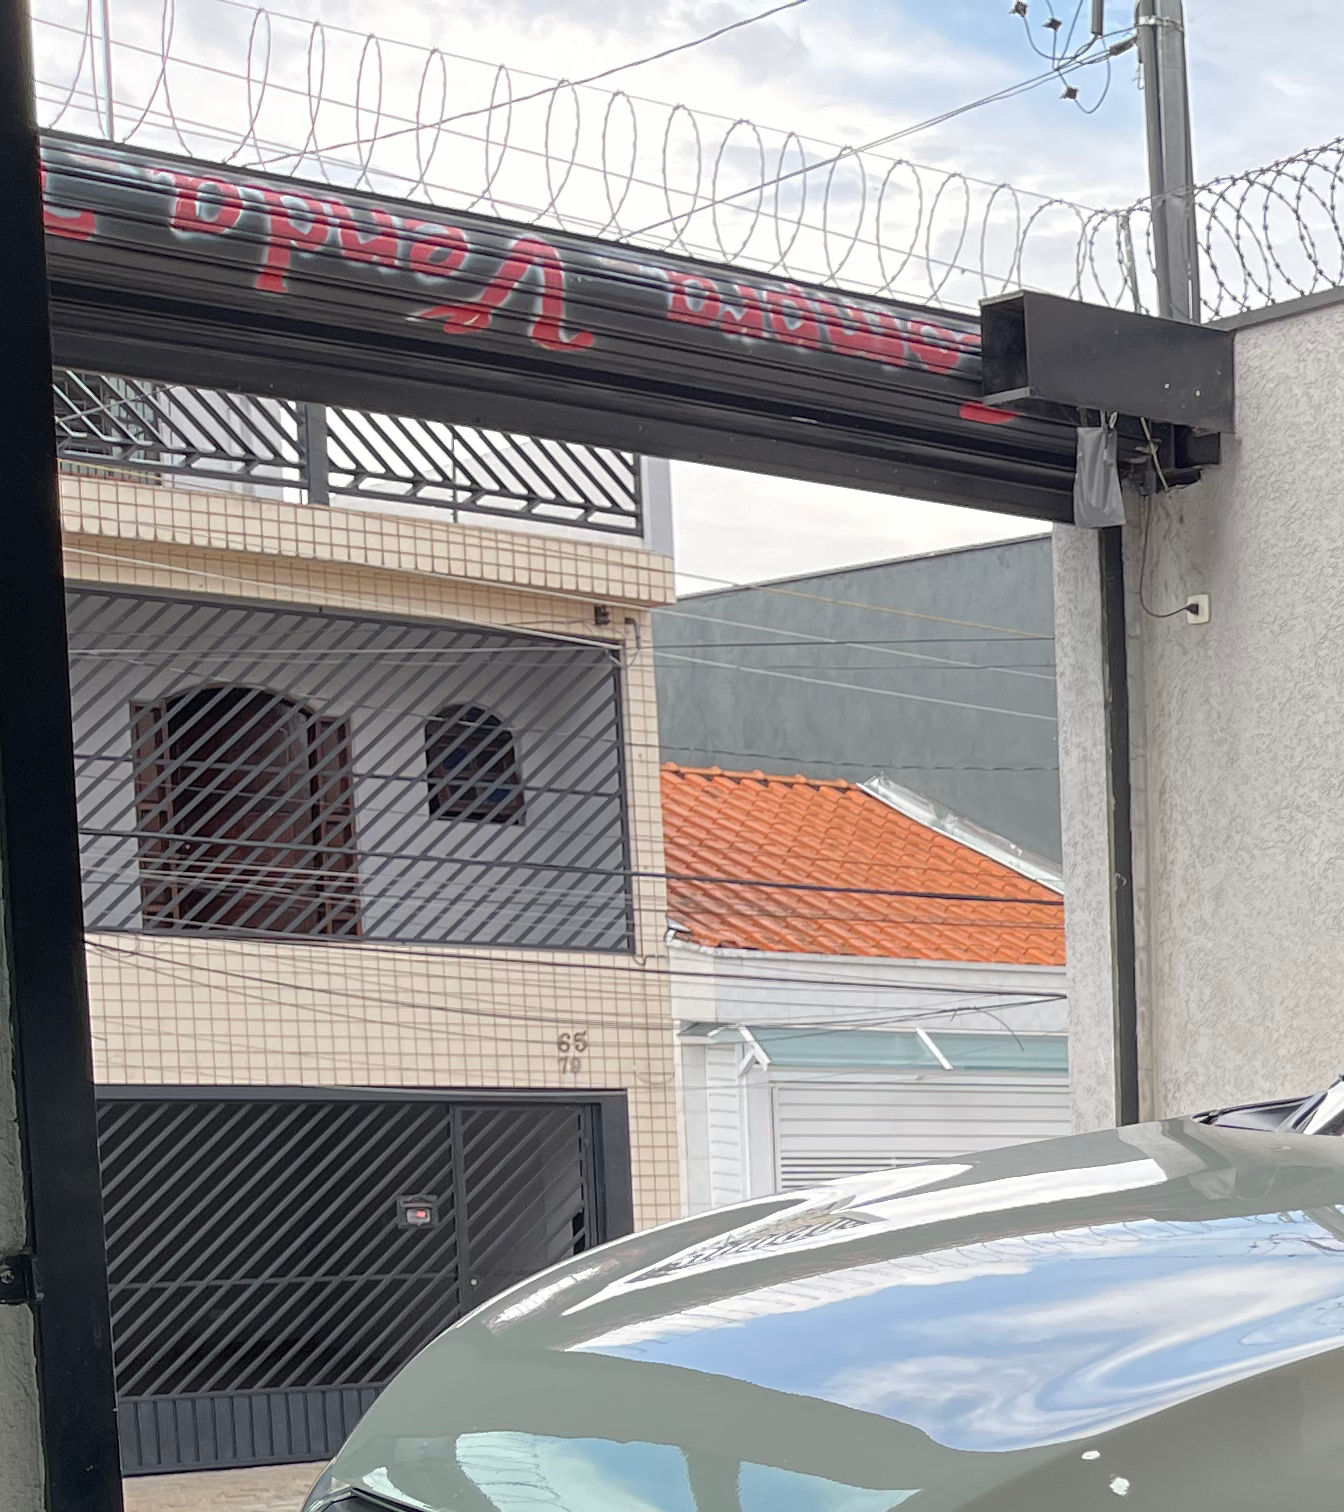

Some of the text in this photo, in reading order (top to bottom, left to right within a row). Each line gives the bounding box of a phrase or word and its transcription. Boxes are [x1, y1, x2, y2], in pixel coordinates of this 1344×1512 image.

[148, 168, 595, 351] Venda
[664, 268, 1020, 425] ompra
[557, 1030, 587, 1053] 65
